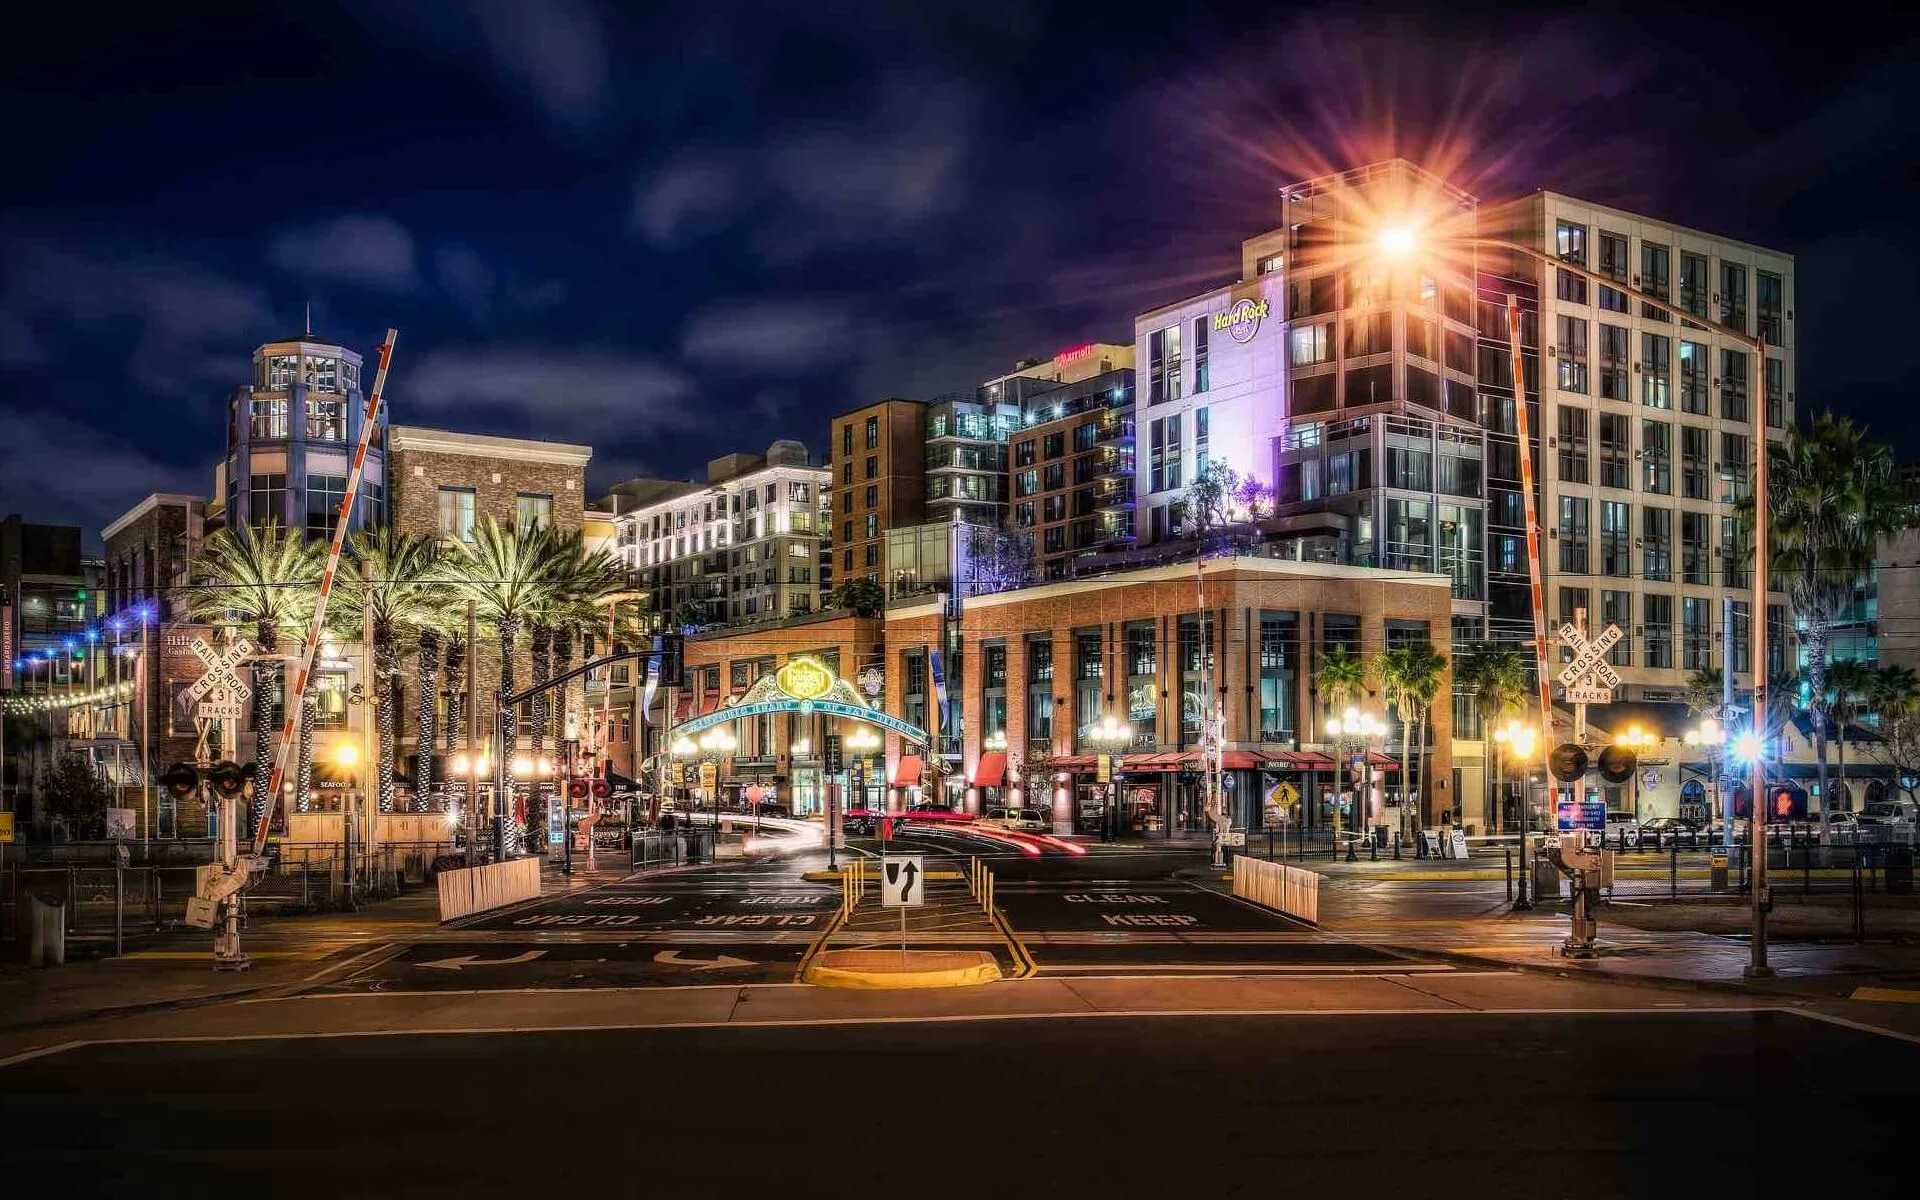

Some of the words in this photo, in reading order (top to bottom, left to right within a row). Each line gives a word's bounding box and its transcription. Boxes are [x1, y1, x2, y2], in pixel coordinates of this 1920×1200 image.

[1214, 307, 1241, 331] Hard
[1240, 299, 1268, 324] Rock
[1055, 344, 1091, 368] Marriott
[1563, 629, 1618, 682] CROSSING
[193, 643, 248, 695] CROSSING
[218, 690, 225, 701] 3
[1568, 690, 1609, 700] TRACKS
[201, 705, 241, 715] TRACKS
[739, 895, 822, 905] KEEP
[1063, 894, 1171, 903] CLEAR
[513, 915, 641, 926] CLEAR
[694, 915, 816, 926] CLEAR
[1101, 914, 1199, 926] KEEP
